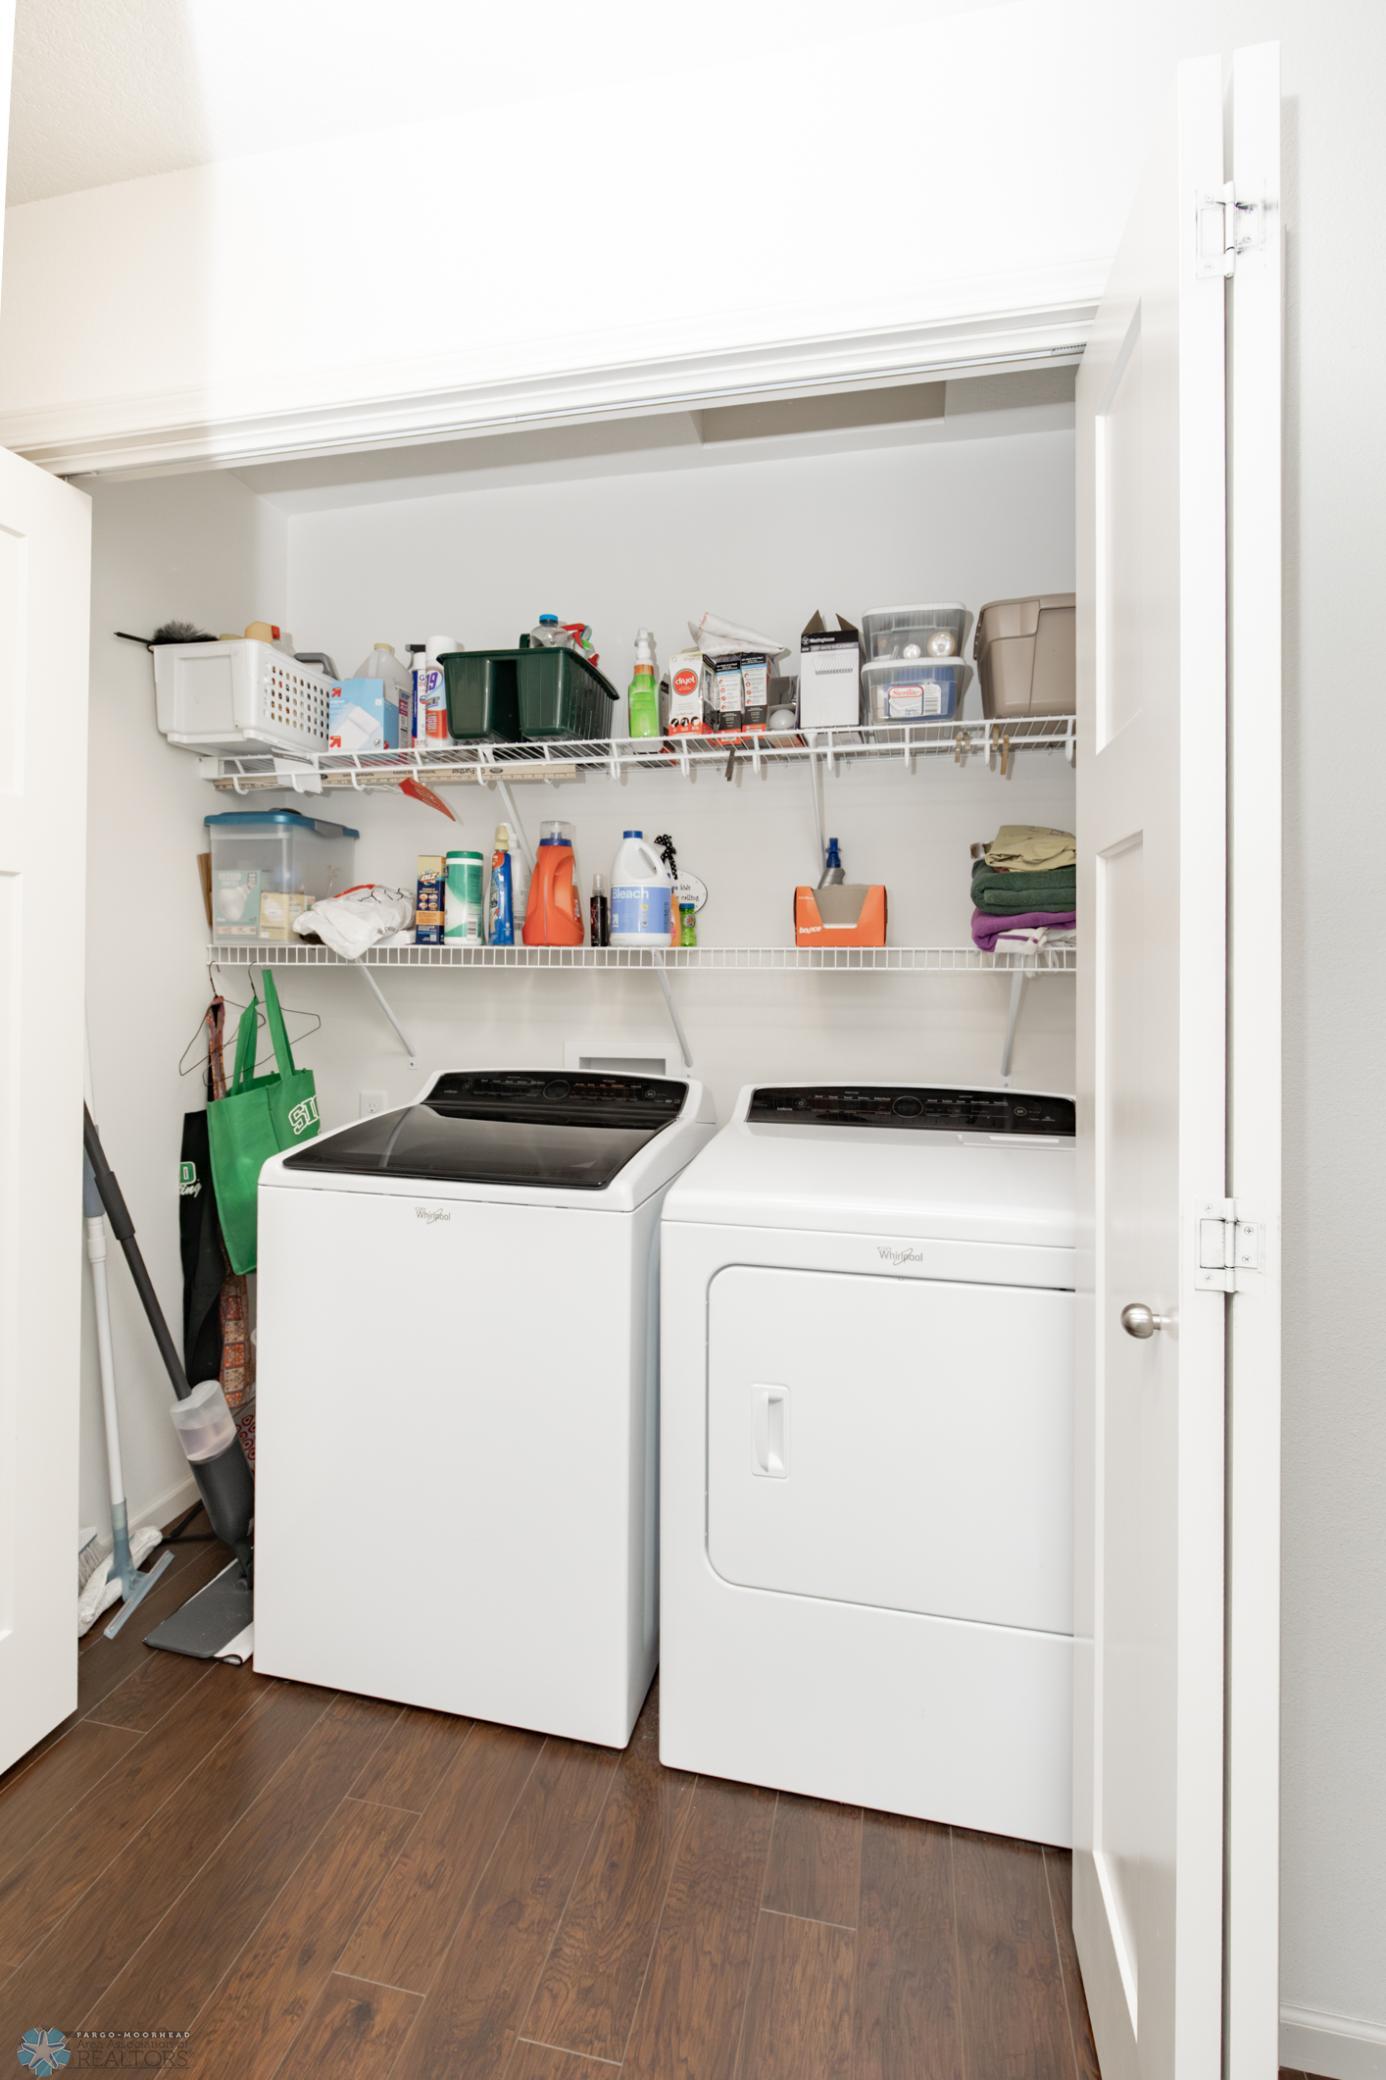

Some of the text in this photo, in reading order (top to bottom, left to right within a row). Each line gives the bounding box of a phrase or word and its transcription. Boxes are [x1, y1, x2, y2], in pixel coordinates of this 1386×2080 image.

[612, 887, 650, 900] Bleach
[414, 1207, 451, 1223] Whirlpool
[877, 1246, 924, 1264] Whirlpool
